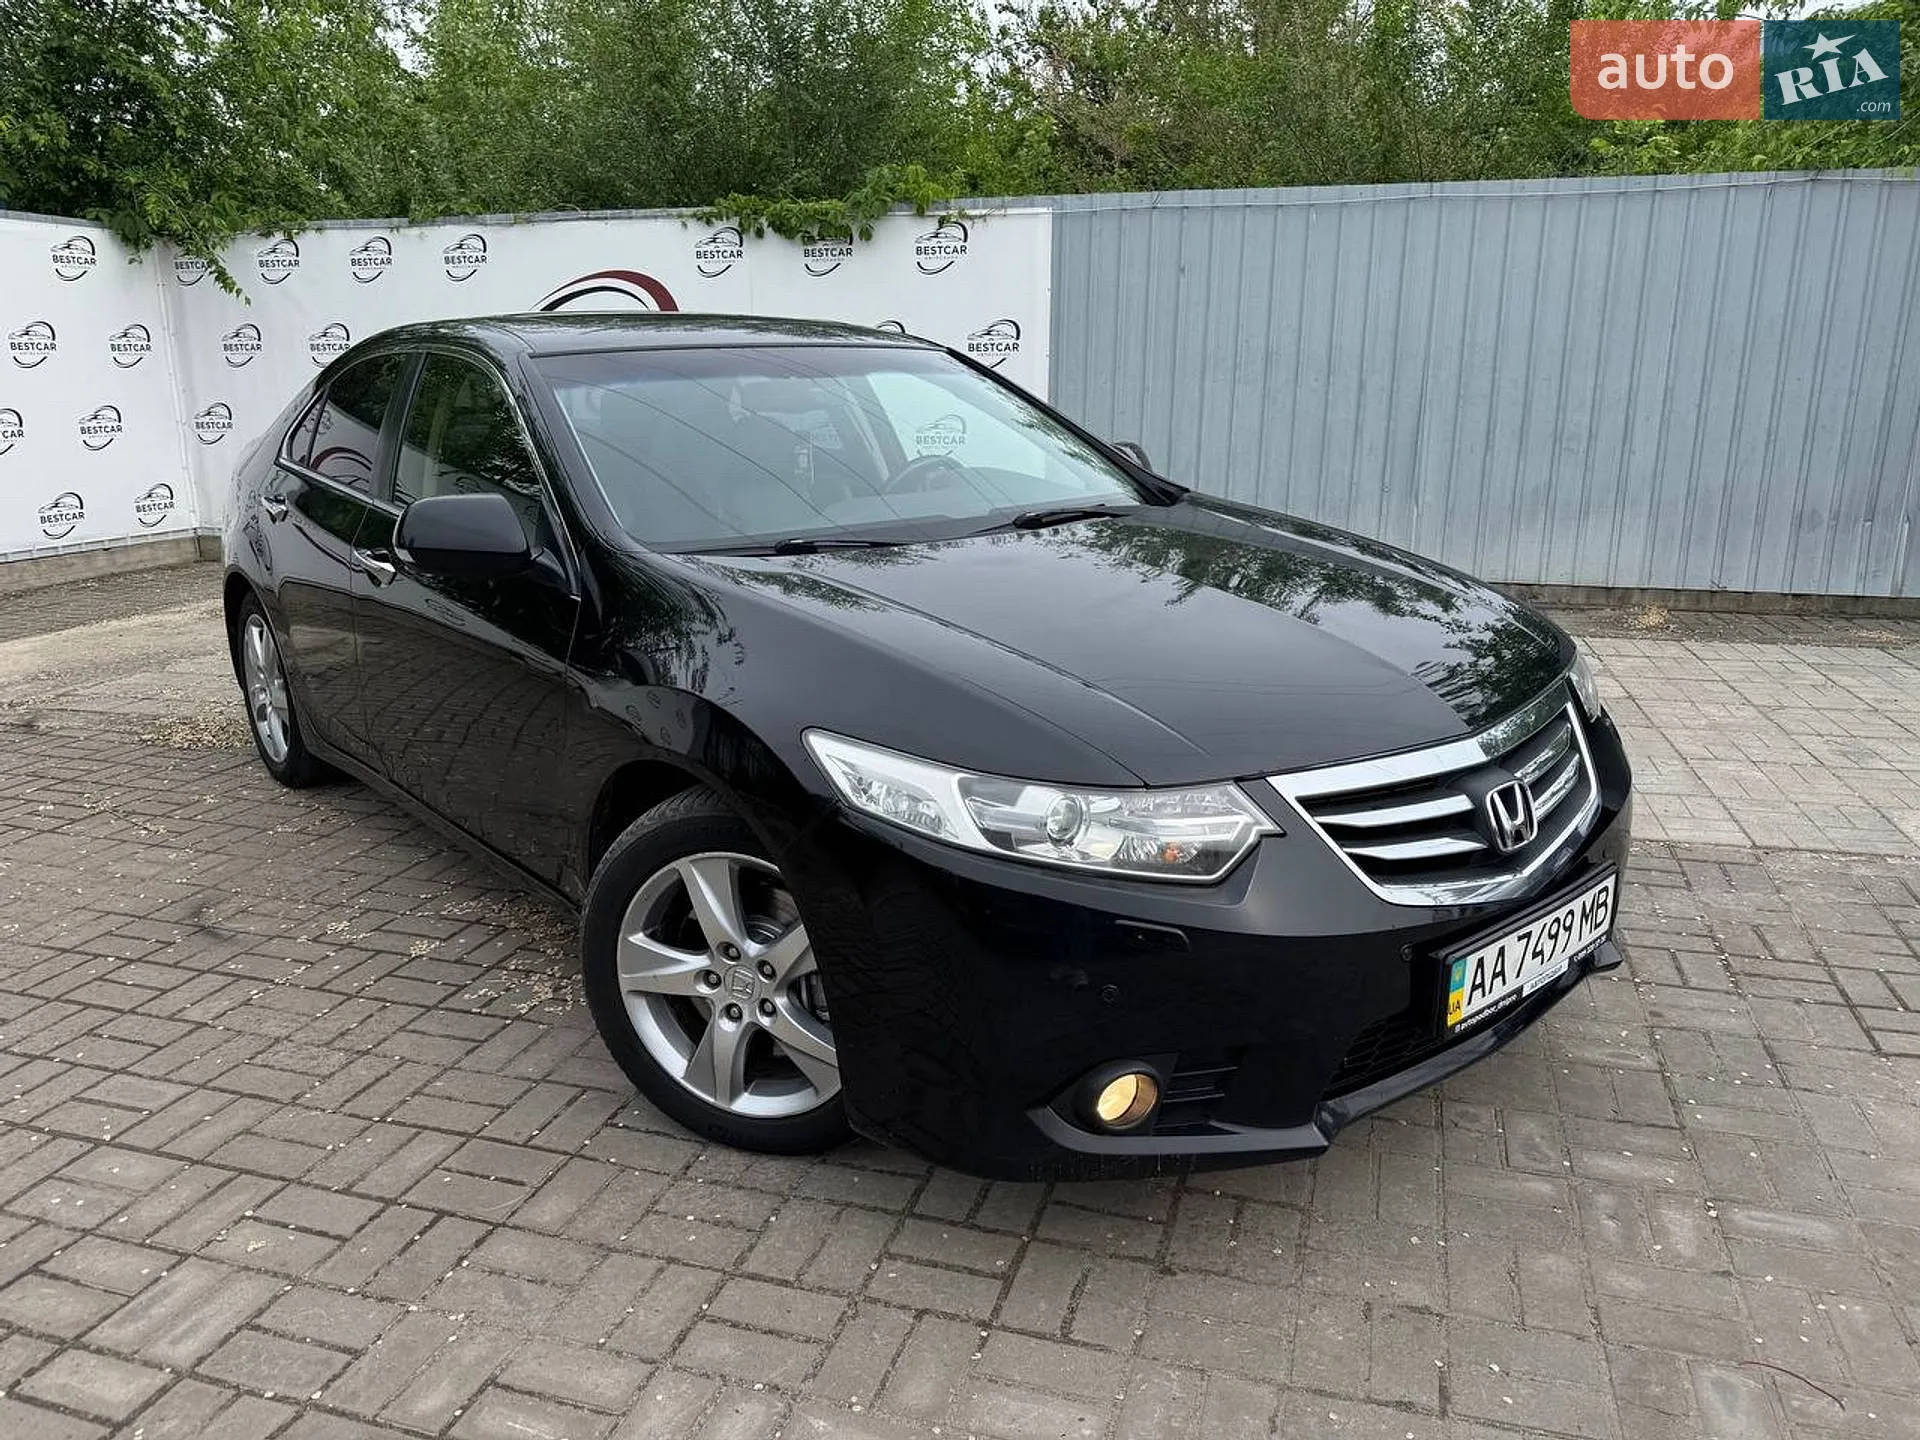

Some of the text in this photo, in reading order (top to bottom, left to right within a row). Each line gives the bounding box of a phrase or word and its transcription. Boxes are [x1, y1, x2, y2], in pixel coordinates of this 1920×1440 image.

[696, 250, 743, 259] BESTCAR
[804, 248, 854, 258] BESTCAR
[916, 245, 967, 256] BESTCAR
[52, 254, 97, 265] BESTCAR
[258, 259, 300, 268] BESTCAR
[351, 257, 392, 267] BESTCAR
[444, 256, 487, 265] BESTCAR
[10, 341, 57, 351] BESTCAR
[110, 343, 152, 352] BESTCAR
[224, 343, 262, 352] BESTCAR
[310, 343, 350, 352] BESTCAR
[968, 343, 1020, 352] BESTCAR
[80, 425, 123, 435] BESTCAR
[196, 422, 233, 431] BESTCAR
[136, 502, 175, 513] BESTCAR
[40, 512, 85, 524] BESTCAR
[1467, 947, 1507, 1005] AA
[1516, 910, 1574, 978] 7499
[1580, 885, 1609, 942] MB
